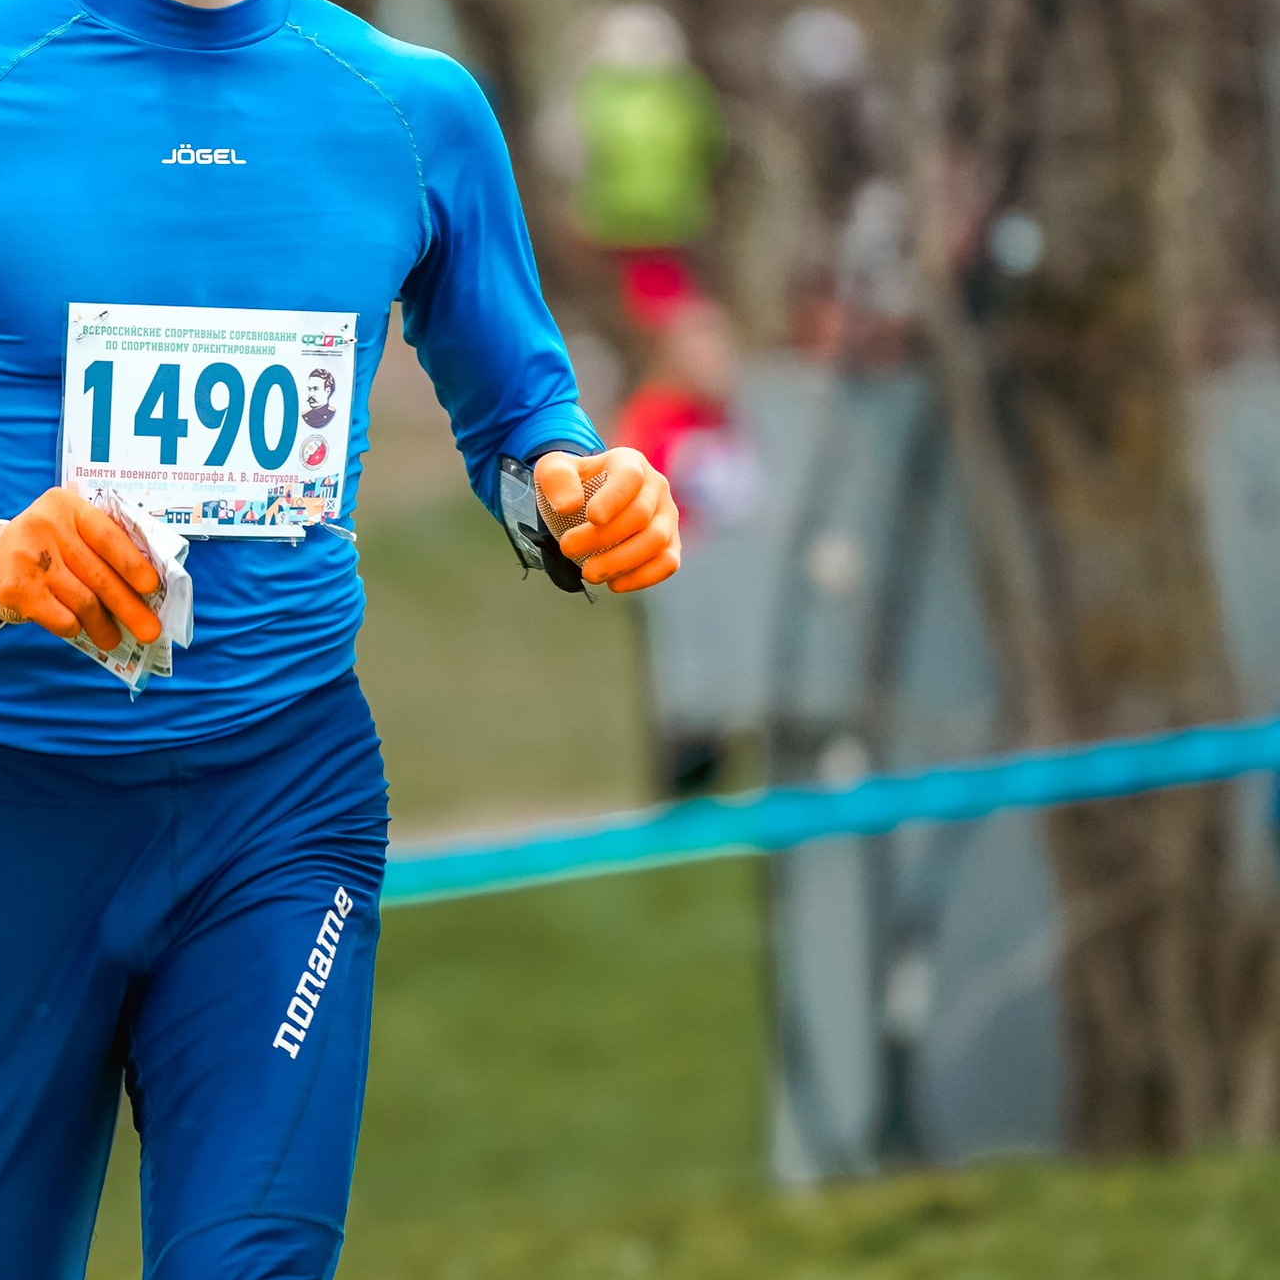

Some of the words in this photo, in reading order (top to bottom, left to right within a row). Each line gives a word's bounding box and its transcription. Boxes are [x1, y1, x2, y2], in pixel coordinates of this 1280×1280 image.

[161, 143, 247, 165] JÖGEL
[82, 325, 162, 338] ВСЕРОССИЙСКИЕ
[164, 328, 227, 340] СПОРТИВНЫЕ
[229, 330, 298, 342] СОРЕВНОВАНИЯ
[105, 340, 118, 350] ПО
[121, 341, 190, 353] СПОРТИВНОМУ
[192, 343, 276, 356] ОРИЕНТИРОВАНИЮ
[83, 359, 300, 471] 1490
[75, 466, 117, 478] Памяти
[120, 469, 168, 480] военного
[171, 470, 224, 484] топографа
[227, 472, 237, 482] А.
[240, 473, 249, 483] В.
[252, 472, 299, 486] Пастухова
[272, 886, 354, 1060] noname
